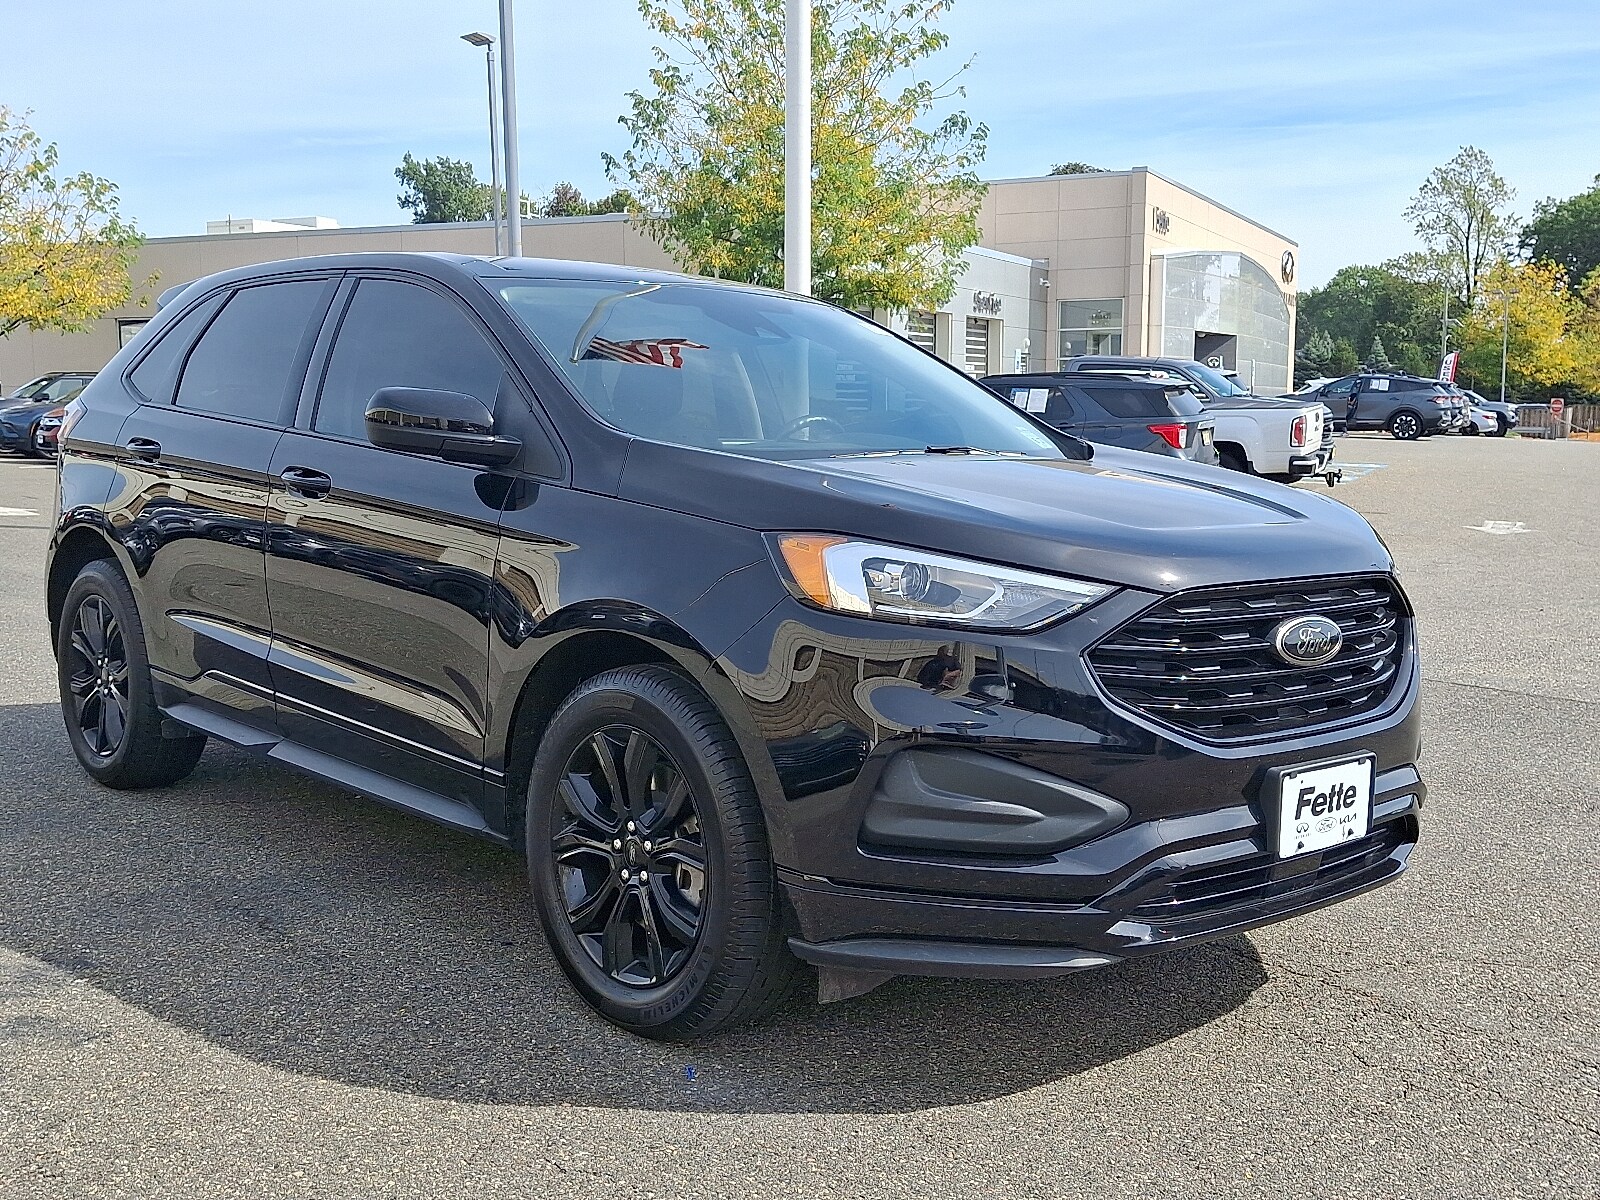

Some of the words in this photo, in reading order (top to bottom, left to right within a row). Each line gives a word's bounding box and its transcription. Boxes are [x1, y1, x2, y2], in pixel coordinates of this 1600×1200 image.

[1297, 627, 1332, 655] Ford
[1294, 782, 1357, 820] Fette
[643, 972, 699, 1020] MICHELIN
